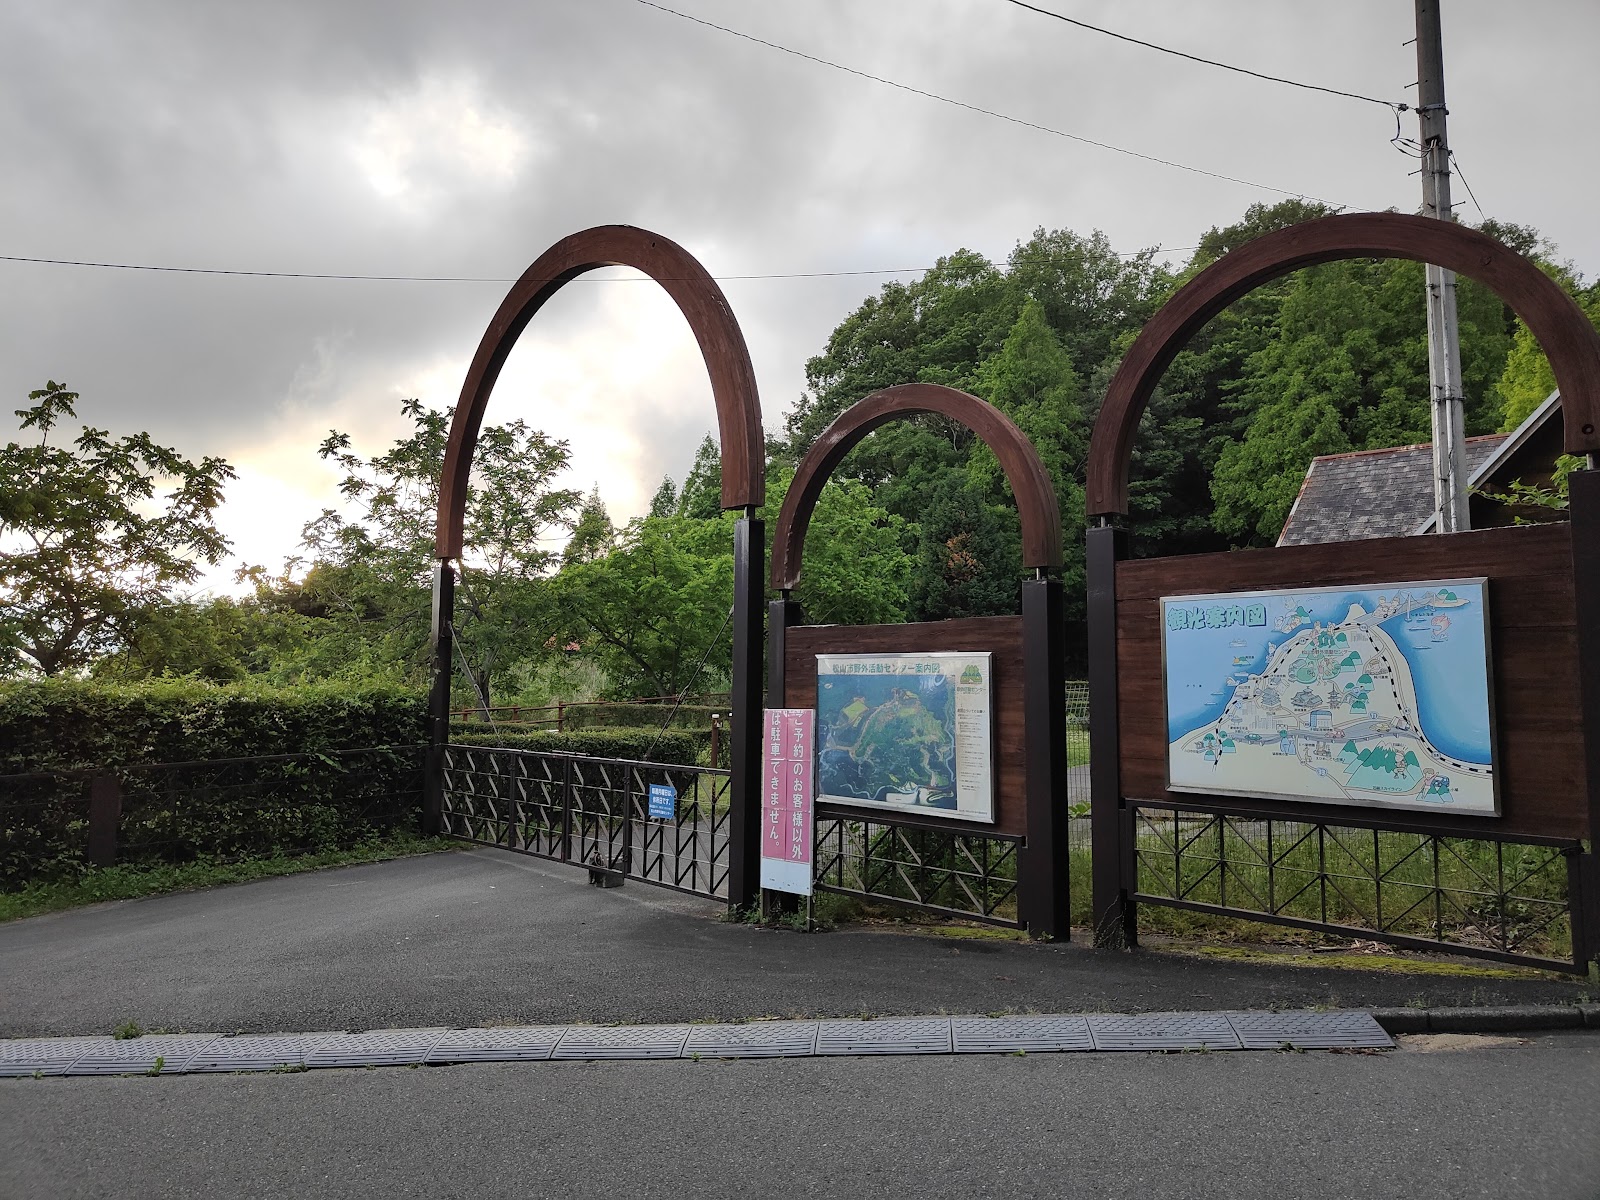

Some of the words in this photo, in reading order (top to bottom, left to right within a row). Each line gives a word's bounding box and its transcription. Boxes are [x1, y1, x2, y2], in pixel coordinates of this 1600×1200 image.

[1167, 603, 1266, 631] 観光案内図
[832, 663, 941, 674] 松山市野外活動センター案内図
[769, 712, 781, 846] は駐車できません。
